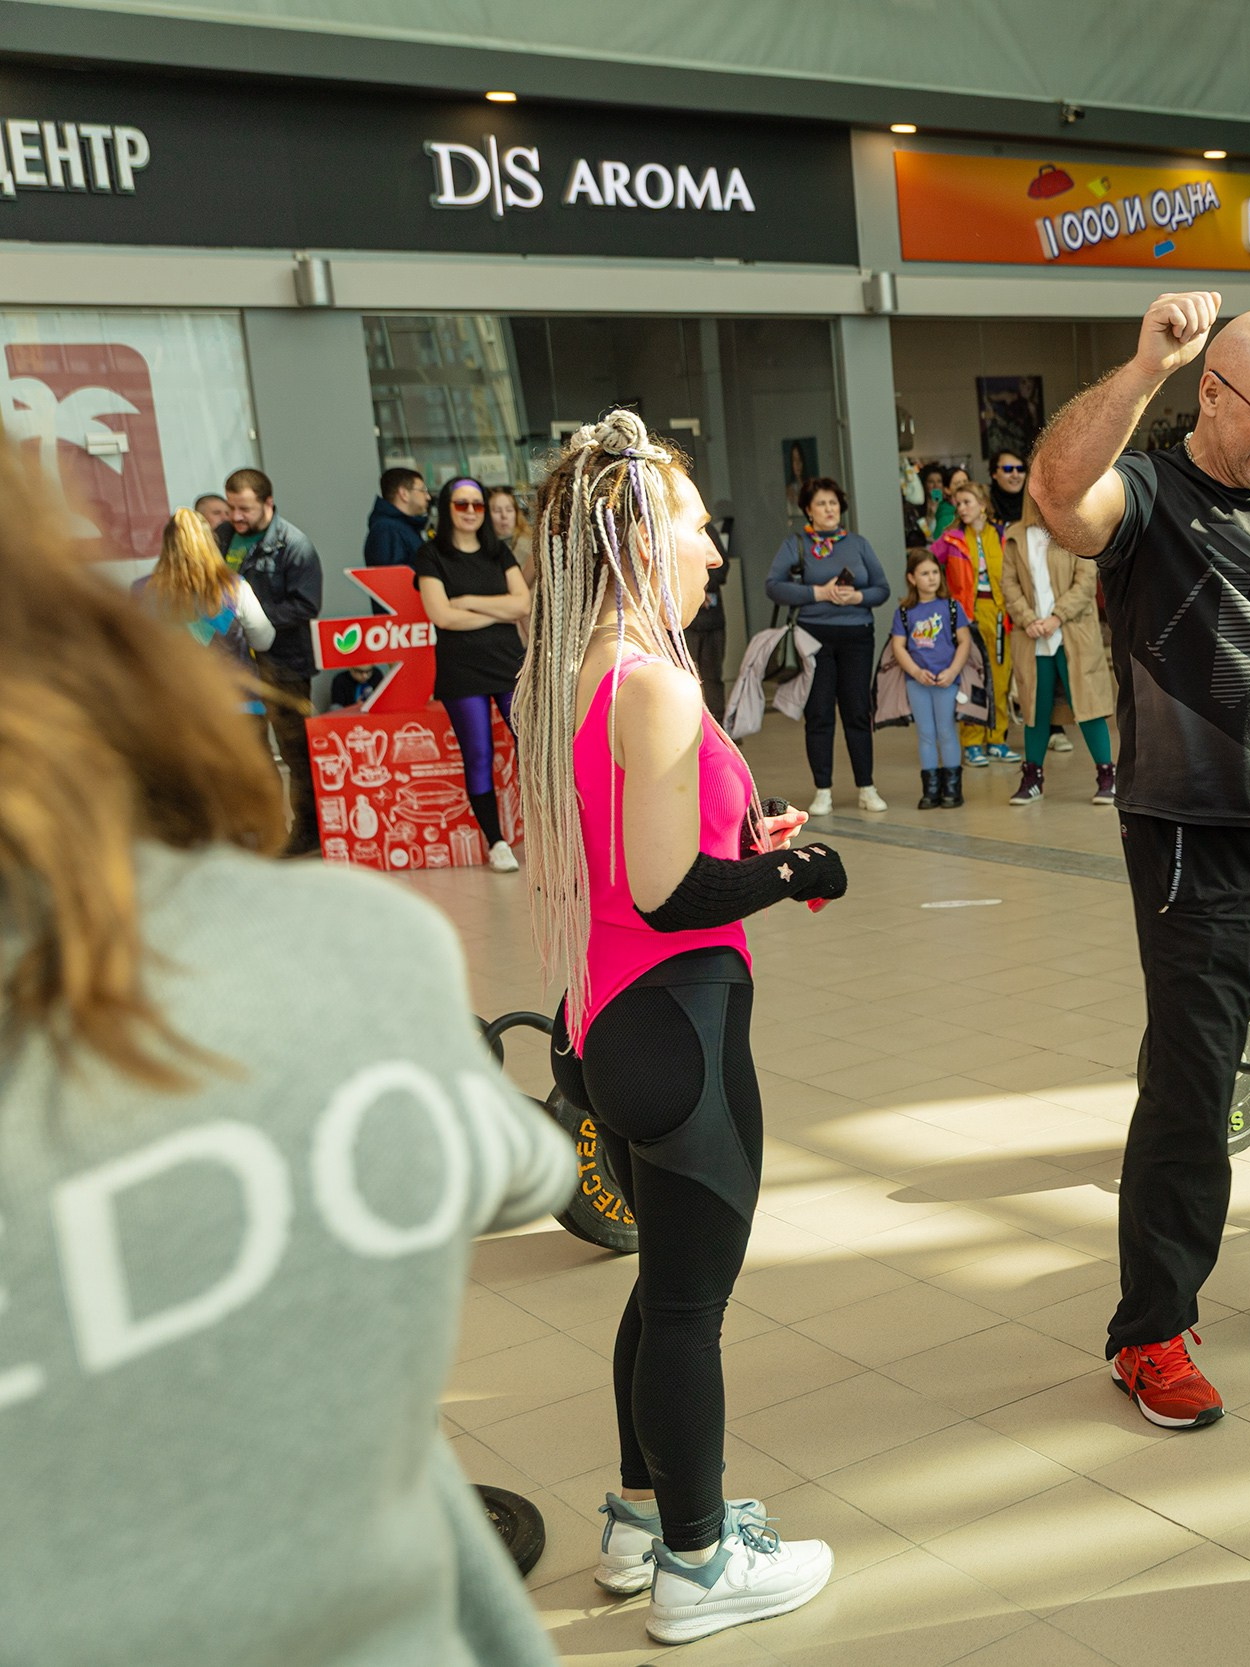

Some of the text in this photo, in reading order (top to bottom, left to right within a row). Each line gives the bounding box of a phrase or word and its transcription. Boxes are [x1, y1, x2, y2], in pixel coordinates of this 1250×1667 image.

[566, 158, 756, 212] AROMA
[1124, 195, 1147, 235] И
[1151, 180, 1221, 232] ОДНА
